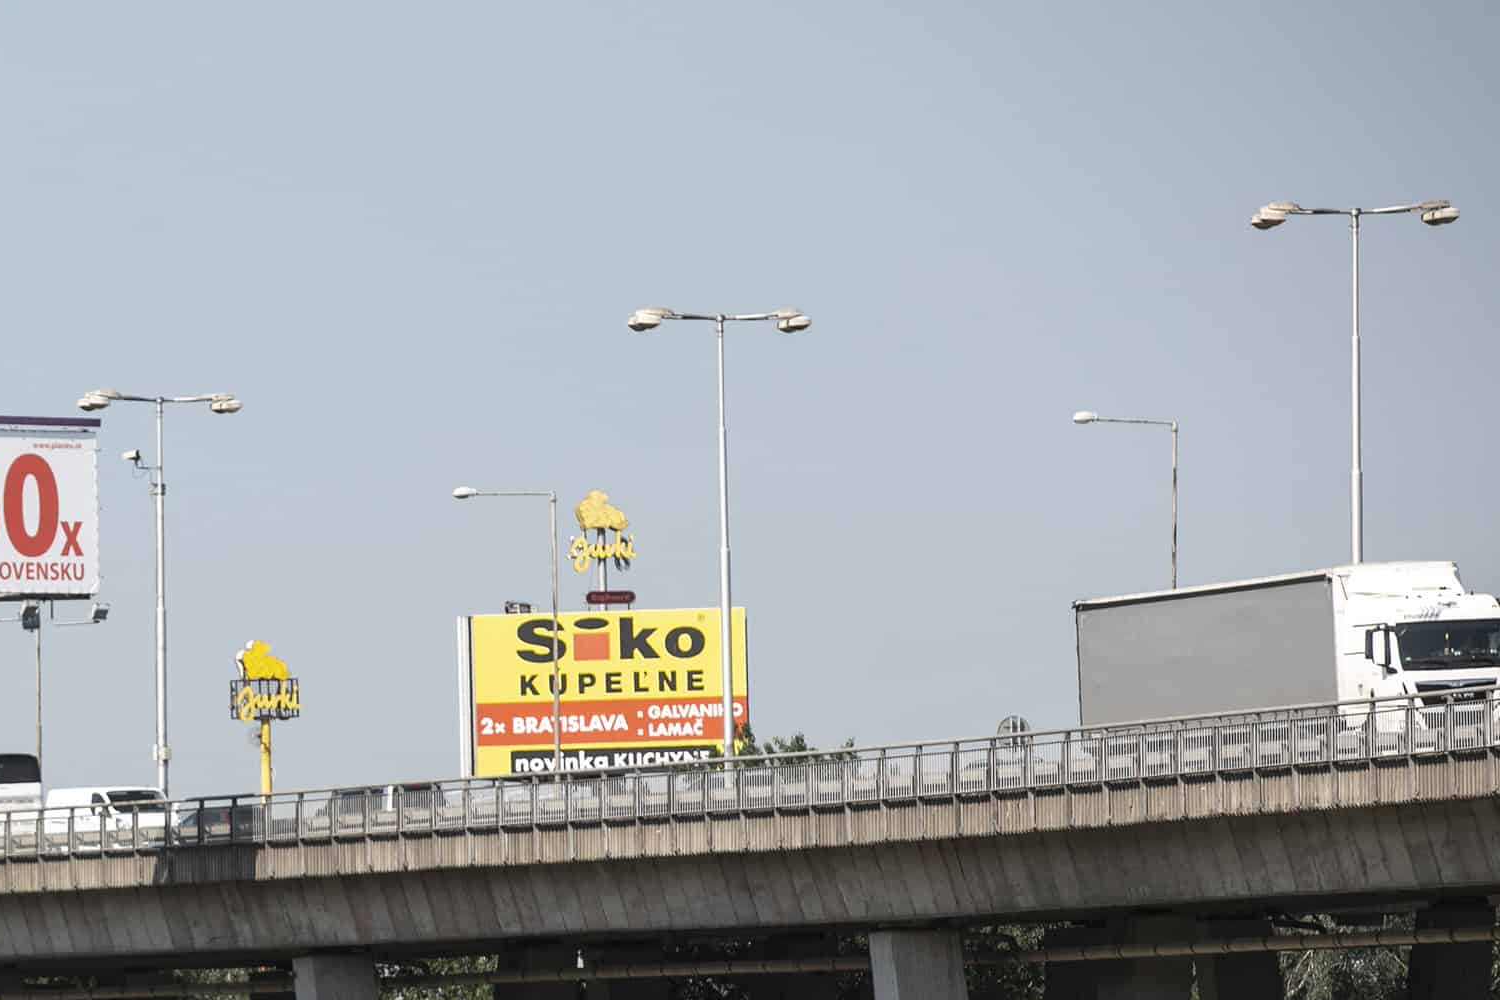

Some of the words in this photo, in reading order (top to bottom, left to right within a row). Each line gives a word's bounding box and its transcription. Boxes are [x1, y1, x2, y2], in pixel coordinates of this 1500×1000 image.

[516, 617, 705, 663] Siko
[481, 719, 506, 735] 2x
[648, 719, 704, 737] LAMAČ
[515, 750, 609, 773] novinka
